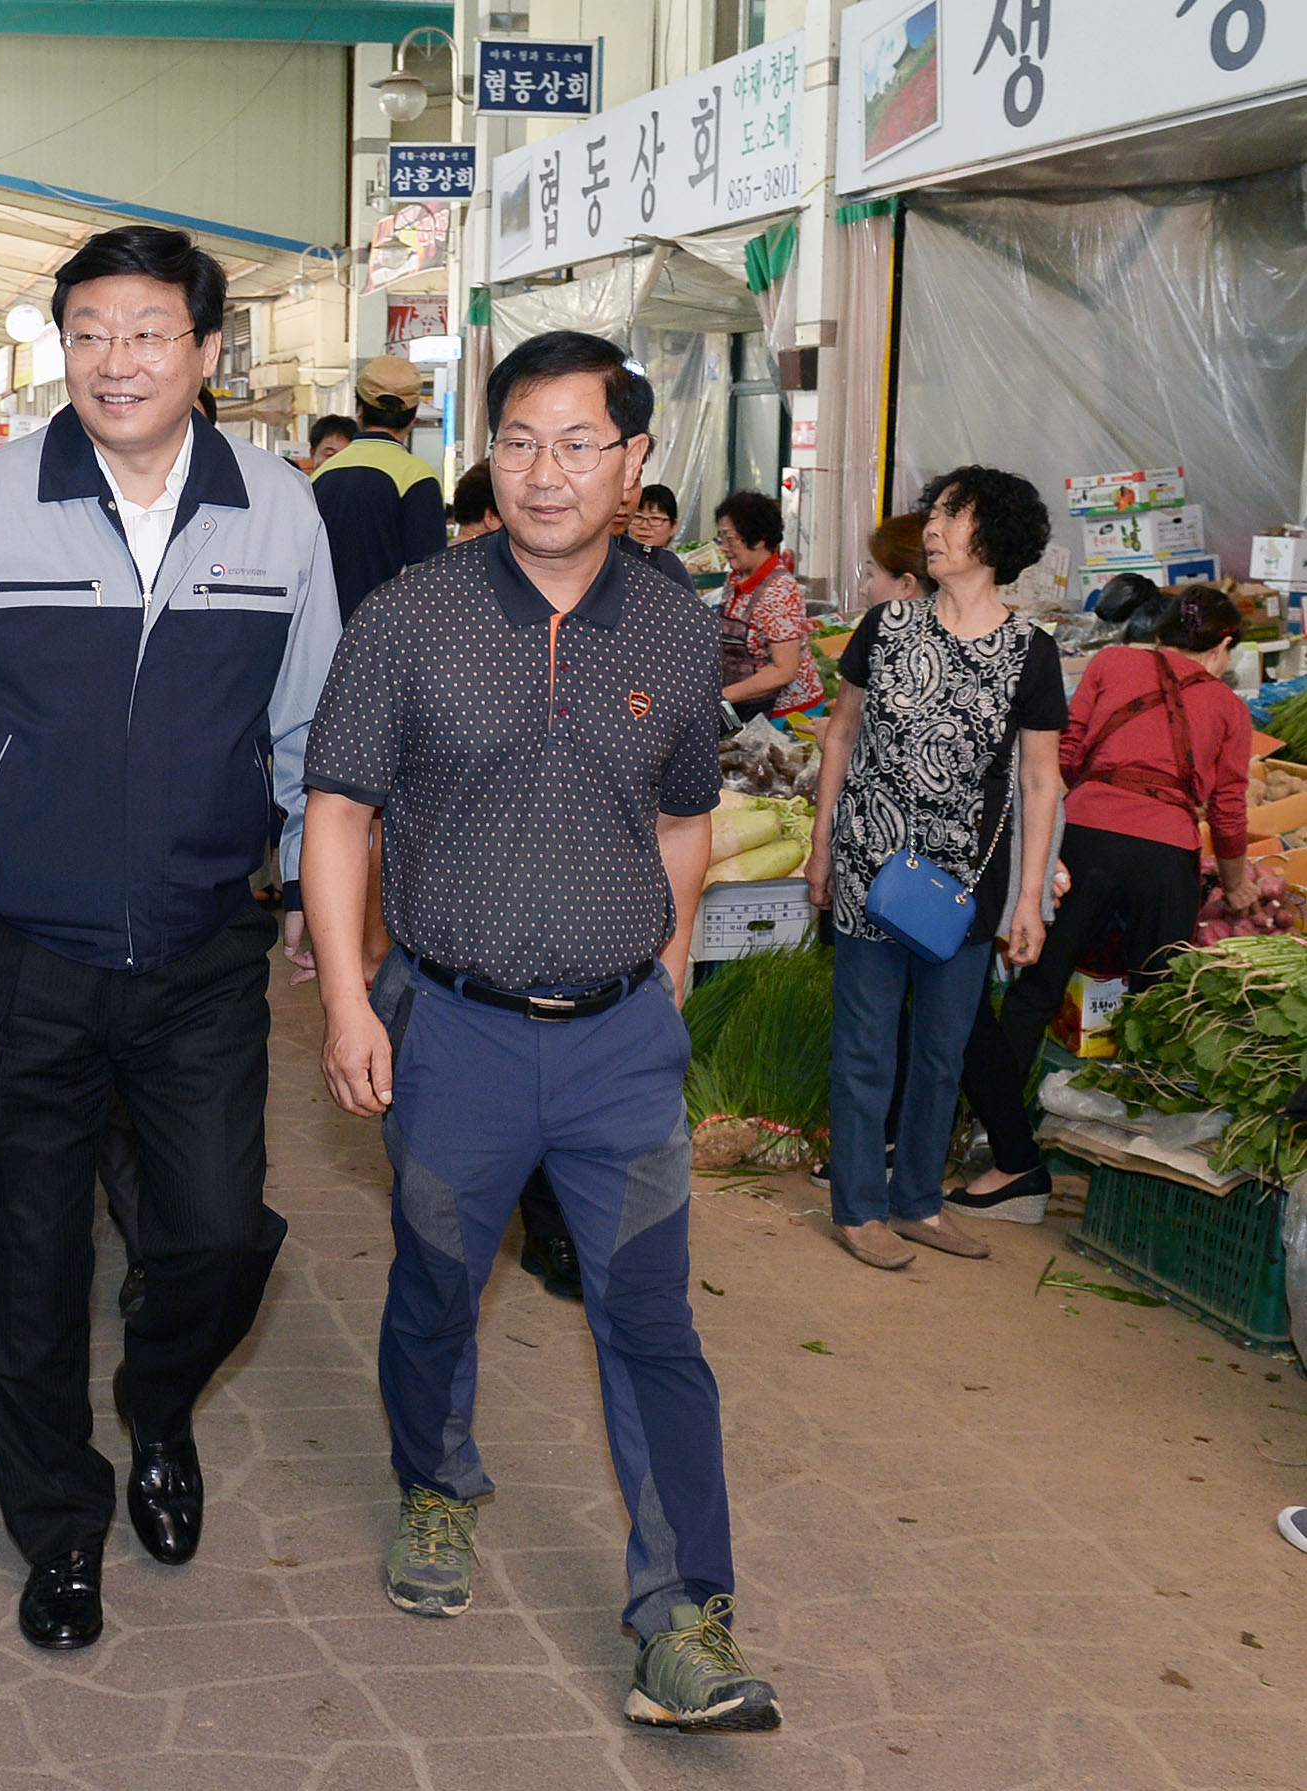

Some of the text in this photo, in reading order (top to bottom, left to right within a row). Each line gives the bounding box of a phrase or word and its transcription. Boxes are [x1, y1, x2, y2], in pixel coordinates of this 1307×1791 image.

[483, 68, 589, 105] 협동상회
[539, 86, 721, 249] 협동상회
[726, 162, 799, 211] 855-3801
